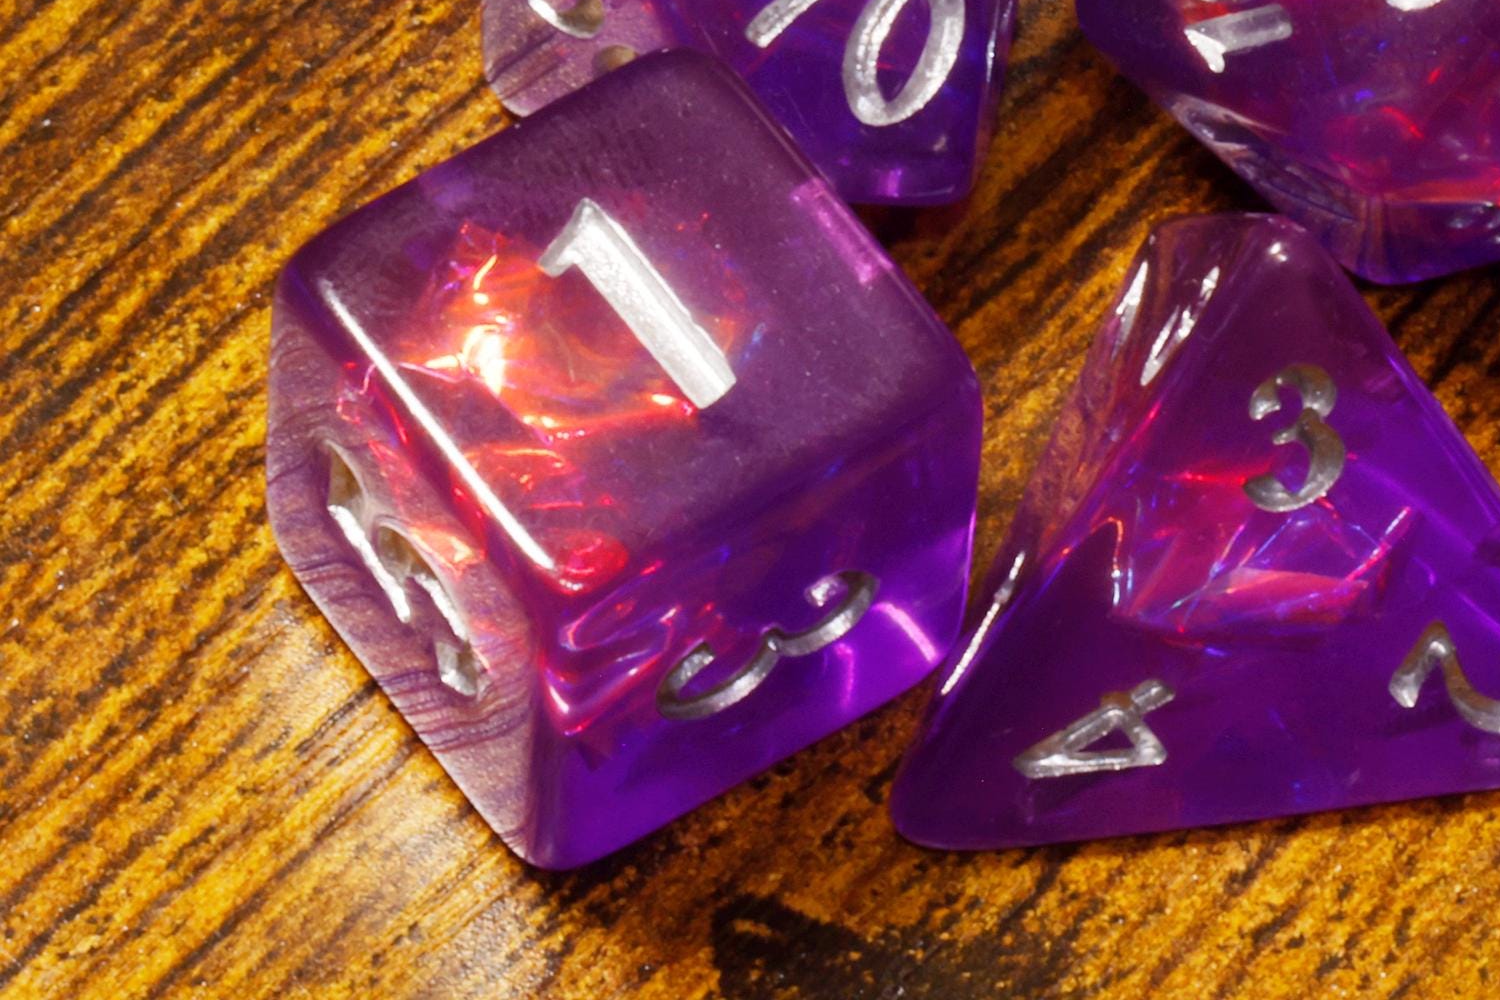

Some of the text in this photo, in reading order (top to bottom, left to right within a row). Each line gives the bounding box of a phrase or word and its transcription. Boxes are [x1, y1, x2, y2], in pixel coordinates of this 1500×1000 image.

[540, 198, 737, 409] 1
[1243, 363, 1345, 512] 3
[655, 570, 880, 720] 3
[1013, 678, 1176, 779] 4
